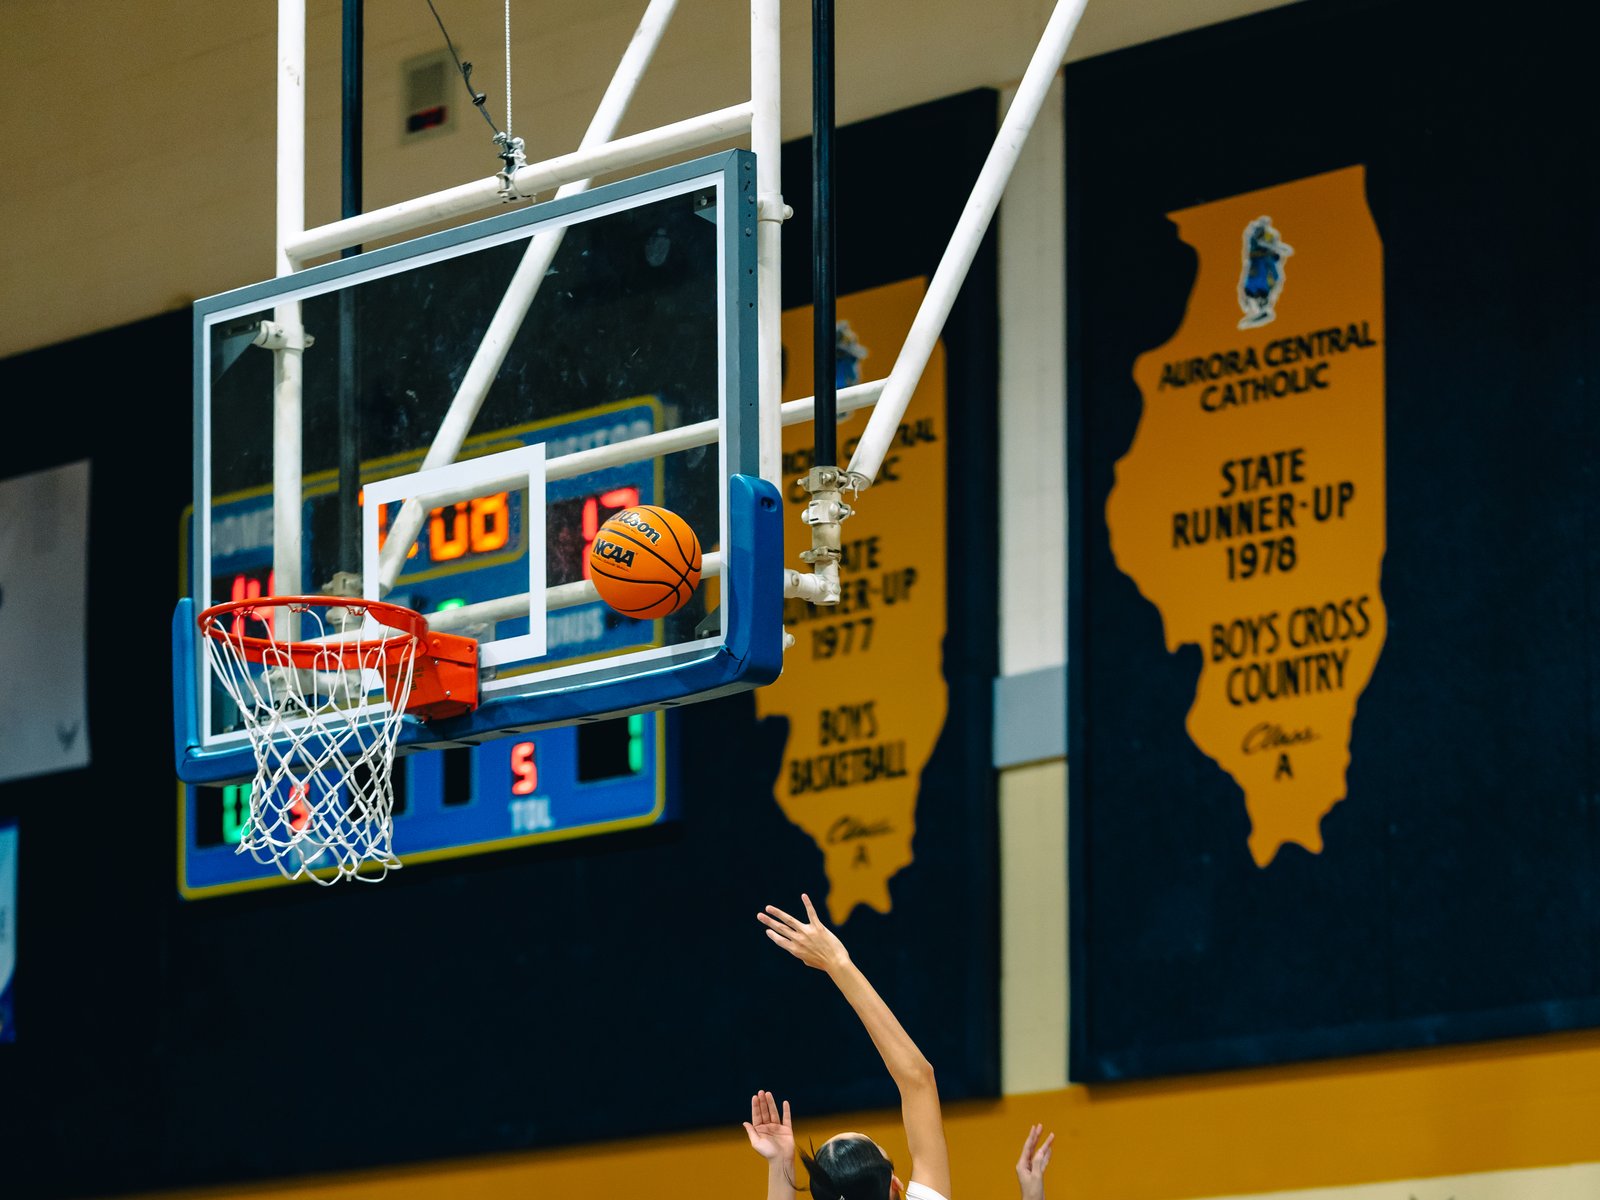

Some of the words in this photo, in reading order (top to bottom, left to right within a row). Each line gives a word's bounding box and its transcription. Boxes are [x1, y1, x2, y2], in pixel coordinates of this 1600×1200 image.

[1158, 345, 1260, 391] AURORA
[1264, 321, 1376, 368] CENTRAL
[1201, 362, 1329, 412] CATHOLIC
[1220, 448, 1305, 499] STATE
[1172, 481, 1354, 549] RUNNER-UP
[592, 538, 636, 568] NCAA
[1227, 536, 1296, 581] 1978
[812, 617, 874, 662] 1977
[1212, 612, 1280, 663] BOYS
[1289, 595, 1370, 648] CROSS
[1227, 649, 1350, 707] COUNTRY
[819, 699, 878, 747] BOYS
[511, 741, 538, 795] 5
[789, 740, 908, 796] BASKETBALL
[1274, 753, 1294, 781] A
